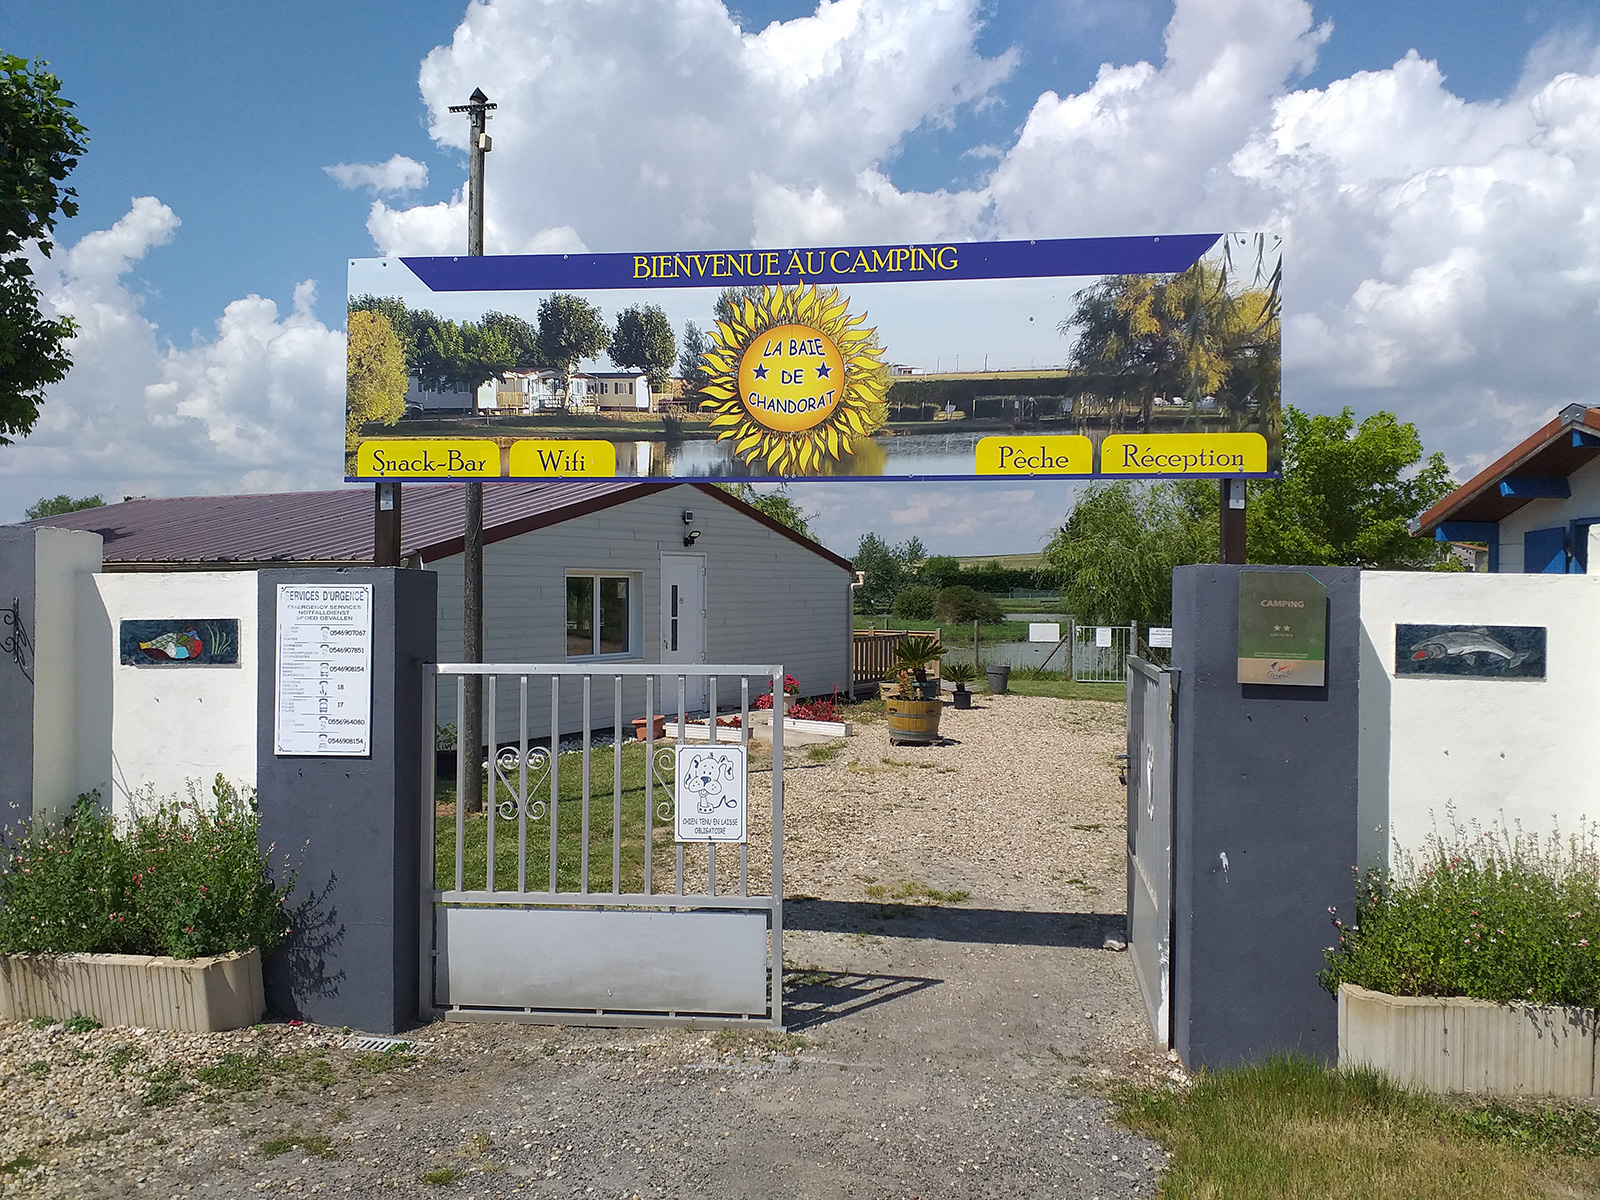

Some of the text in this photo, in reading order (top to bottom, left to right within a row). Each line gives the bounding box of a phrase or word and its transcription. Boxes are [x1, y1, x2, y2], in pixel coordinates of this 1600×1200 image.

[633, 246, 958, 279] BIENVENUE AU CAMPING
[763, 337, 826, 357] LA BAIE
[781, 369, 804, 385] DE
[748, 389, 836, 413] CHANDORAT
[372, 450, 487, 472] Snack-Bar
[537, 450, 586, 472] Wifi
[998, 446, 1069, 469] Pêche
[1122, 443, 1245, 473] Réception
[285, 591, 364, 601] SERVICES D'URGENCE
[1260, 599, 1305, 608] CAMPING
[694, 827, 726, 835] OBLIGATOIRE
[721, 818, 738, 826] LAISSE
